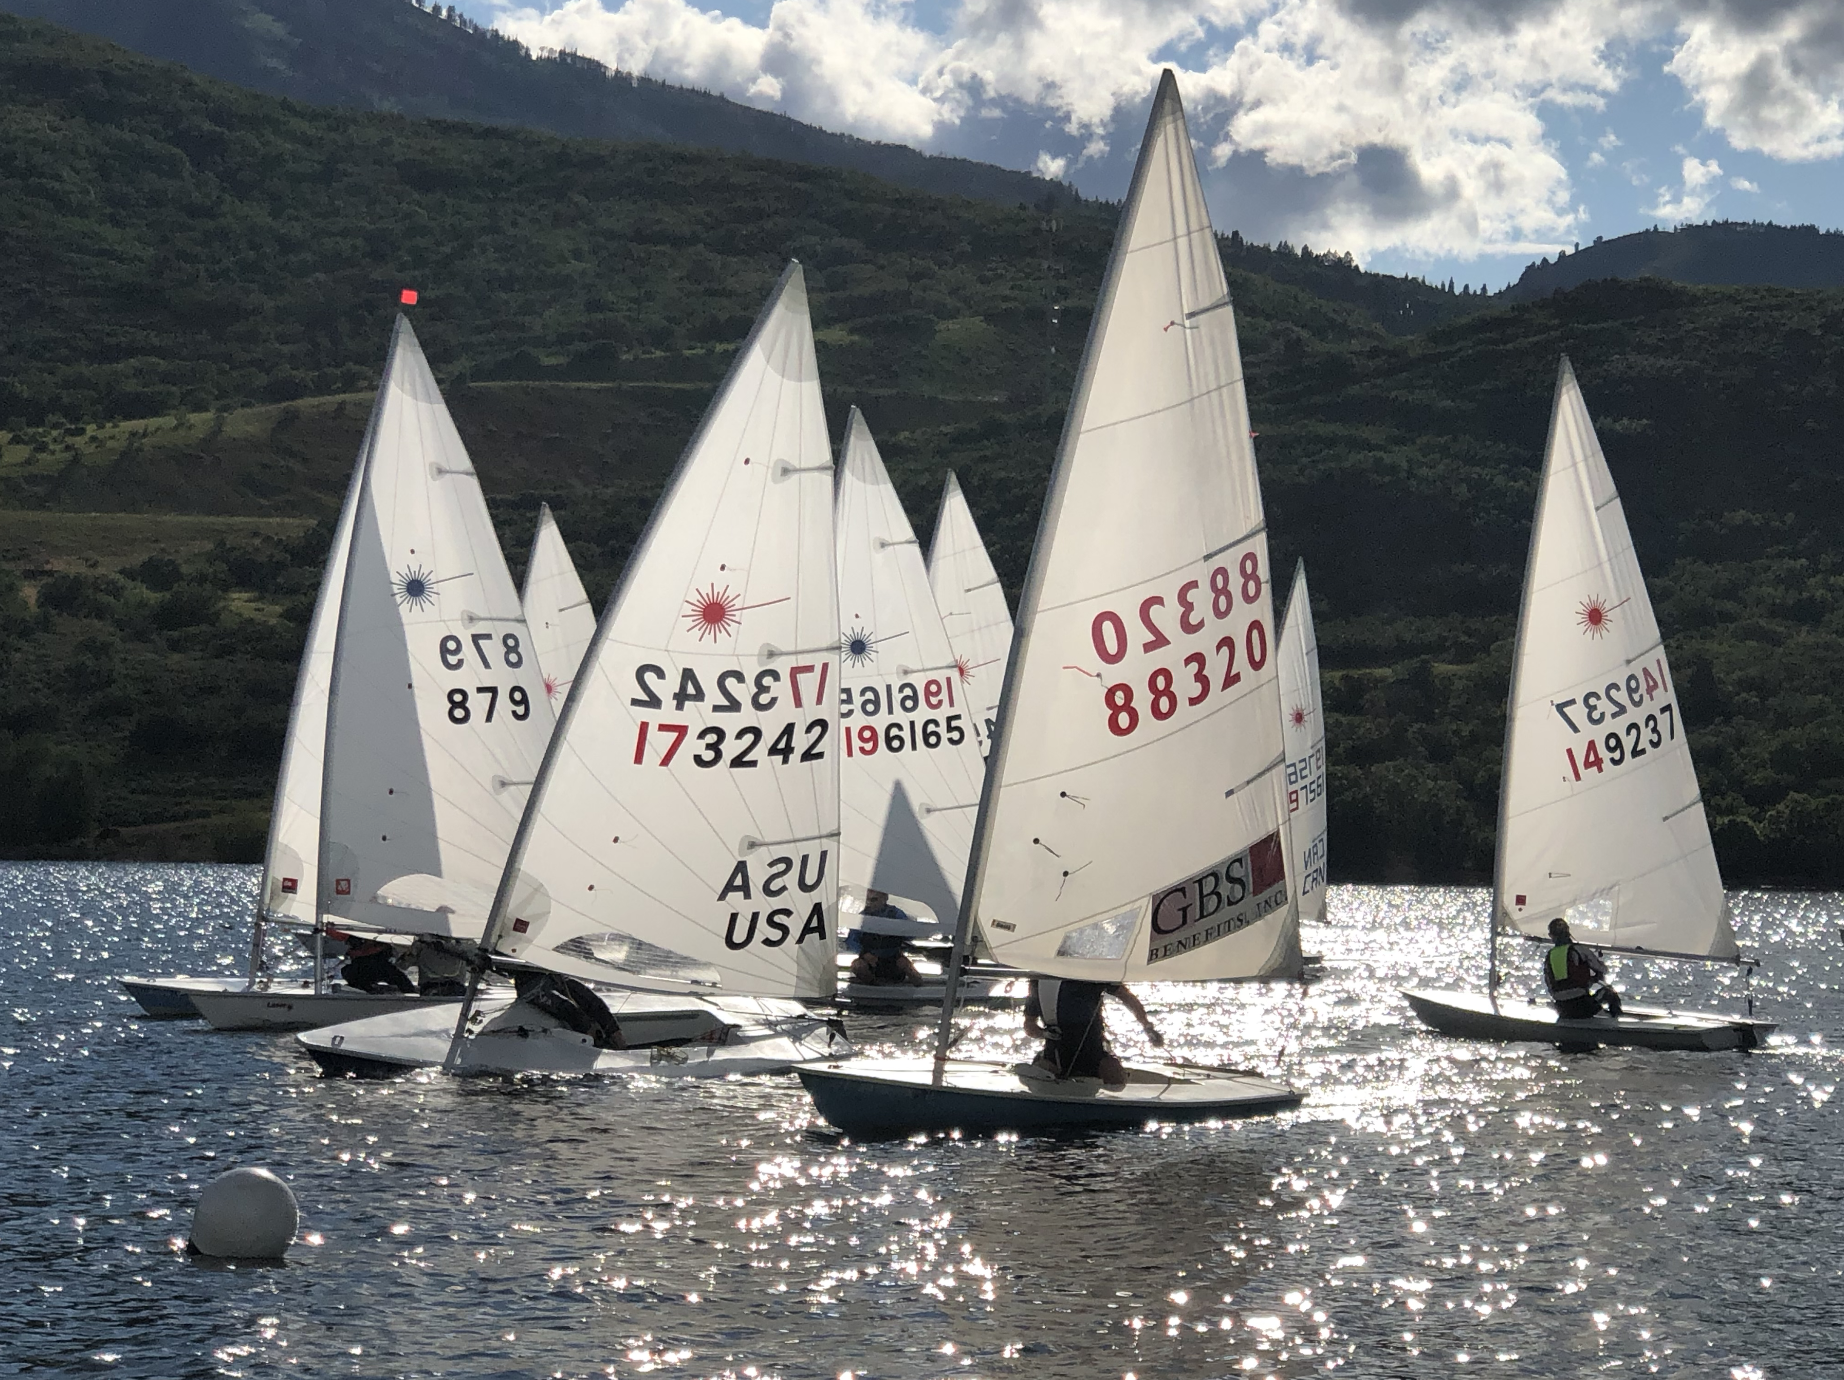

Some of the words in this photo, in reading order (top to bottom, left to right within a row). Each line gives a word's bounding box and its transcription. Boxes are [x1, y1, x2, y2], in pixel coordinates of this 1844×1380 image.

[1104, 619, 1267, 737] 88320
[447, 685, 531, 725] 879
[633, 718, 829, 769] 173242
[845, 714, 965, 758] 196165
[1566, 703, 1675, 782] 149237
[1151, 857, 1247, 935] GBS
[1256, 890, 1288, 917] INC.
[1302, 862, 1326, 896] CAN
[725, 902, 826, 951] USA
